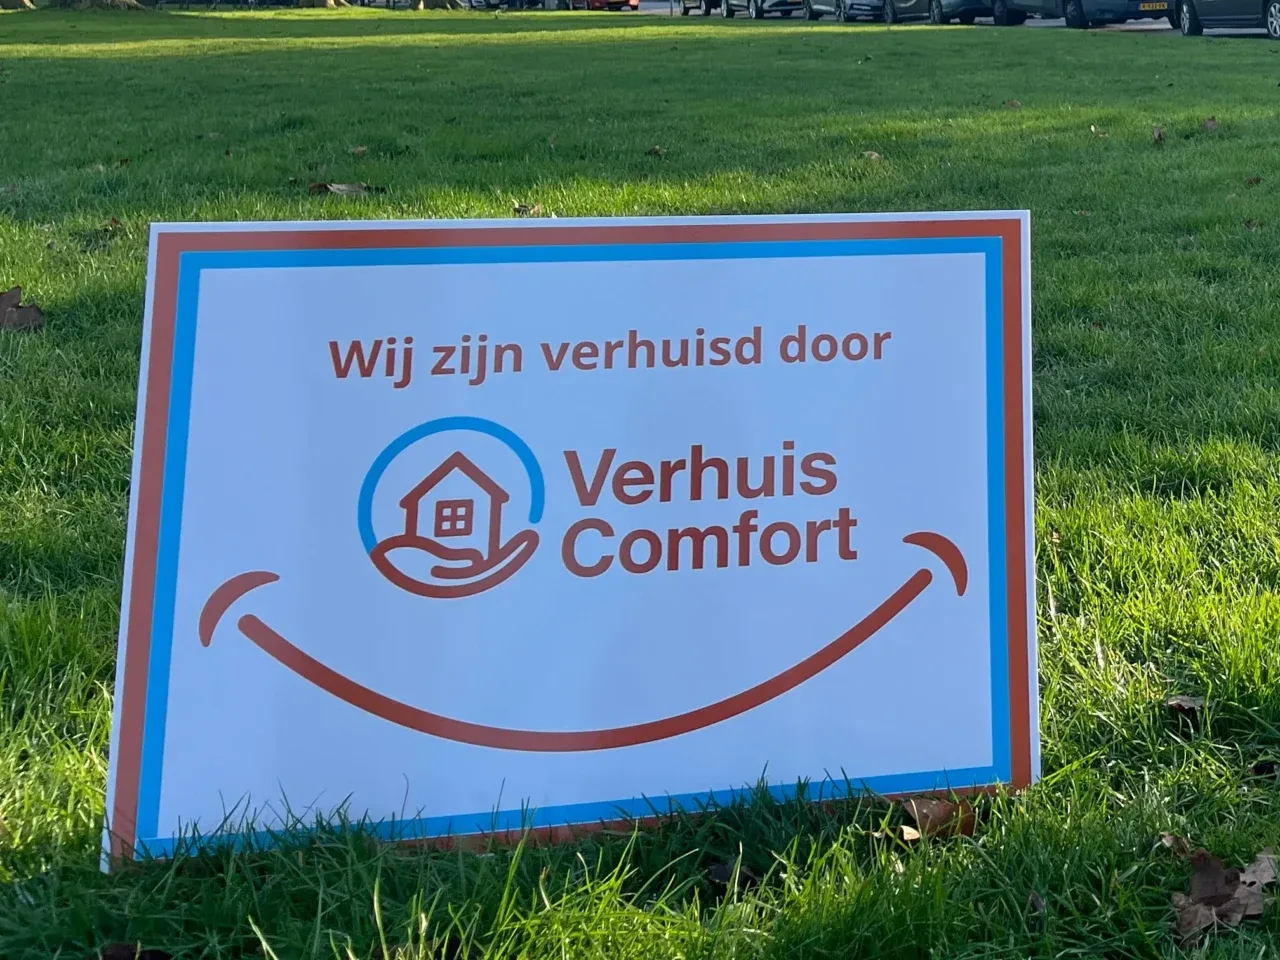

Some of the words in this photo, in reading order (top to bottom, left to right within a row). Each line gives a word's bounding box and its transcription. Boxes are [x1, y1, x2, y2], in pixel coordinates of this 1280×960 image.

[329, 335, 413, 389] Wij
[430, 334, 522, 385] zijn
[541, 326, 761, 370] verhuisd
[780, 325, 893, 363] door
[563, 440, 838, 506] Verhuis
[562, 508, 858, 578] Comfort
